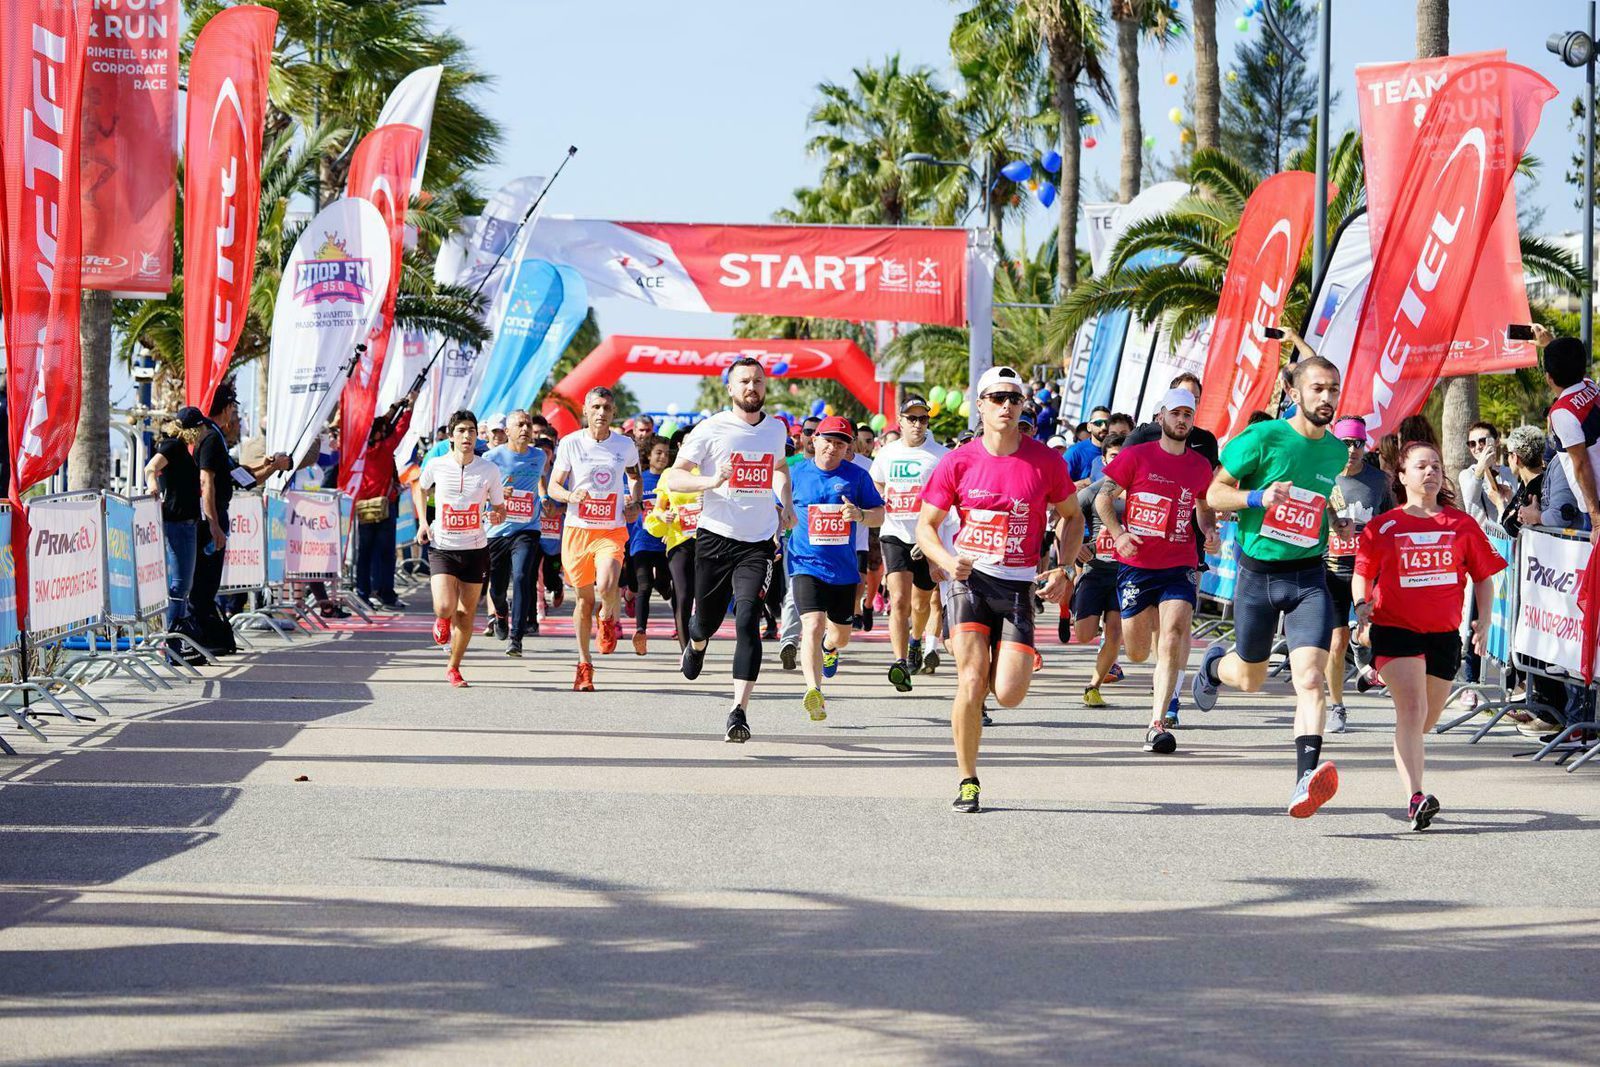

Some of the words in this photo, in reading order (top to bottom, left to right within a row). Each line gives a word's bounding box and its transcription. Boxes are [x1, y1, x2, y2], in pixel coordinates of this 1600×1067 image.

[104, 15, 168, 39] RUN
[86, 46, 137, 60] RIMETEL
[140, 48, 168, 60] 5KM
[92, 61, 168, 75] CORPORATE
[133, 79, 168, 90] RACE
[1368, 73, 1448, 106] TEAM
[1457, 67, 1498, 95] UP
[344, 261, 373, 292] FM
[719, 252, 876, 292] START
[636, 276, 665, 289] ACE
[736, 468, 768, 483] 9480
[504, 499, 532, 512] 10855
[585, 505, 612, 517] 7888
[444, 514, 477, 527] 10519
[1130, 505, 1166, 525] 12957
[1275, 504, 1316, 529] 6540
[230, 514, 252, 534] ETEL
[814, 518, 845, 532] 8769
[1008, 525, 1028, 535] 2018
[1006, 537, 1025, 554] 5K
[1401, 551, 1453, 570] 14318
[1526, 555, 1587, 596] PRIMET
